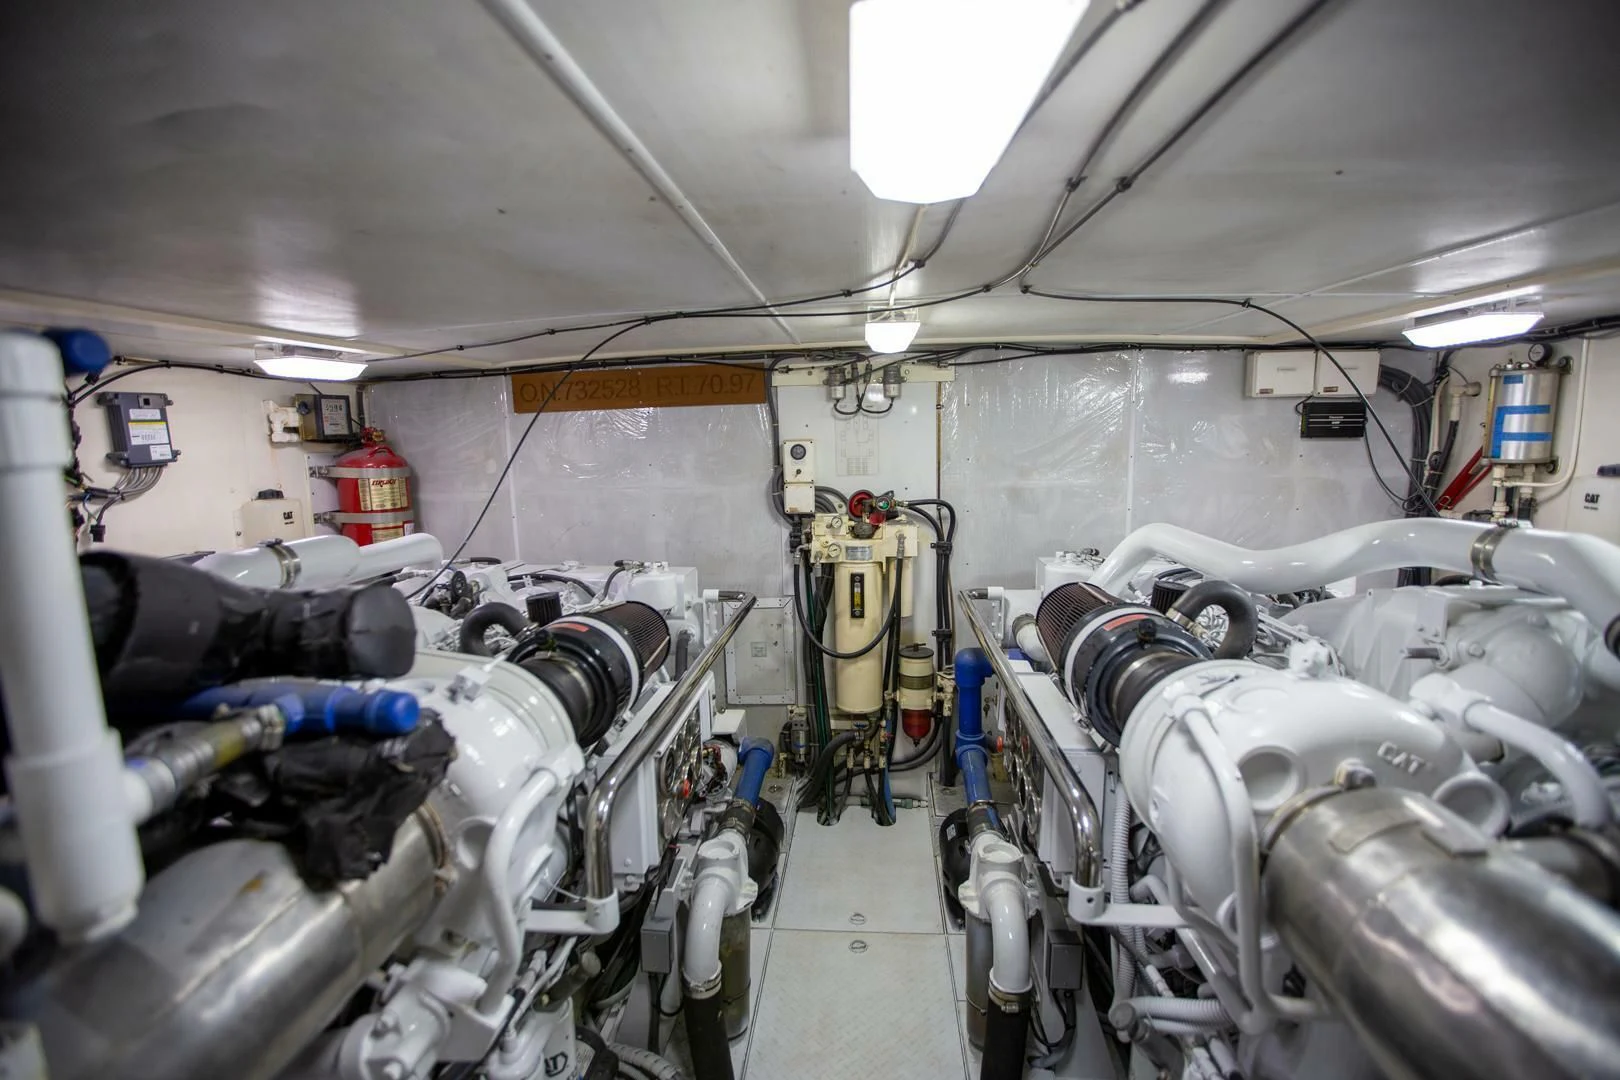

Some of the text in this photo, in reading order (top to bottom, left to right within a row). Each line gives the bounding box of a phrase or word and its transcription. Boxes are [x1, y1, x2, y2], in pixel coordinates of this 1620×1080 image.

[1584, 493, 1600, 504] CAT
[283, 511, 294, 521] CAT
[1377, 741, 1425, 774] CAT
